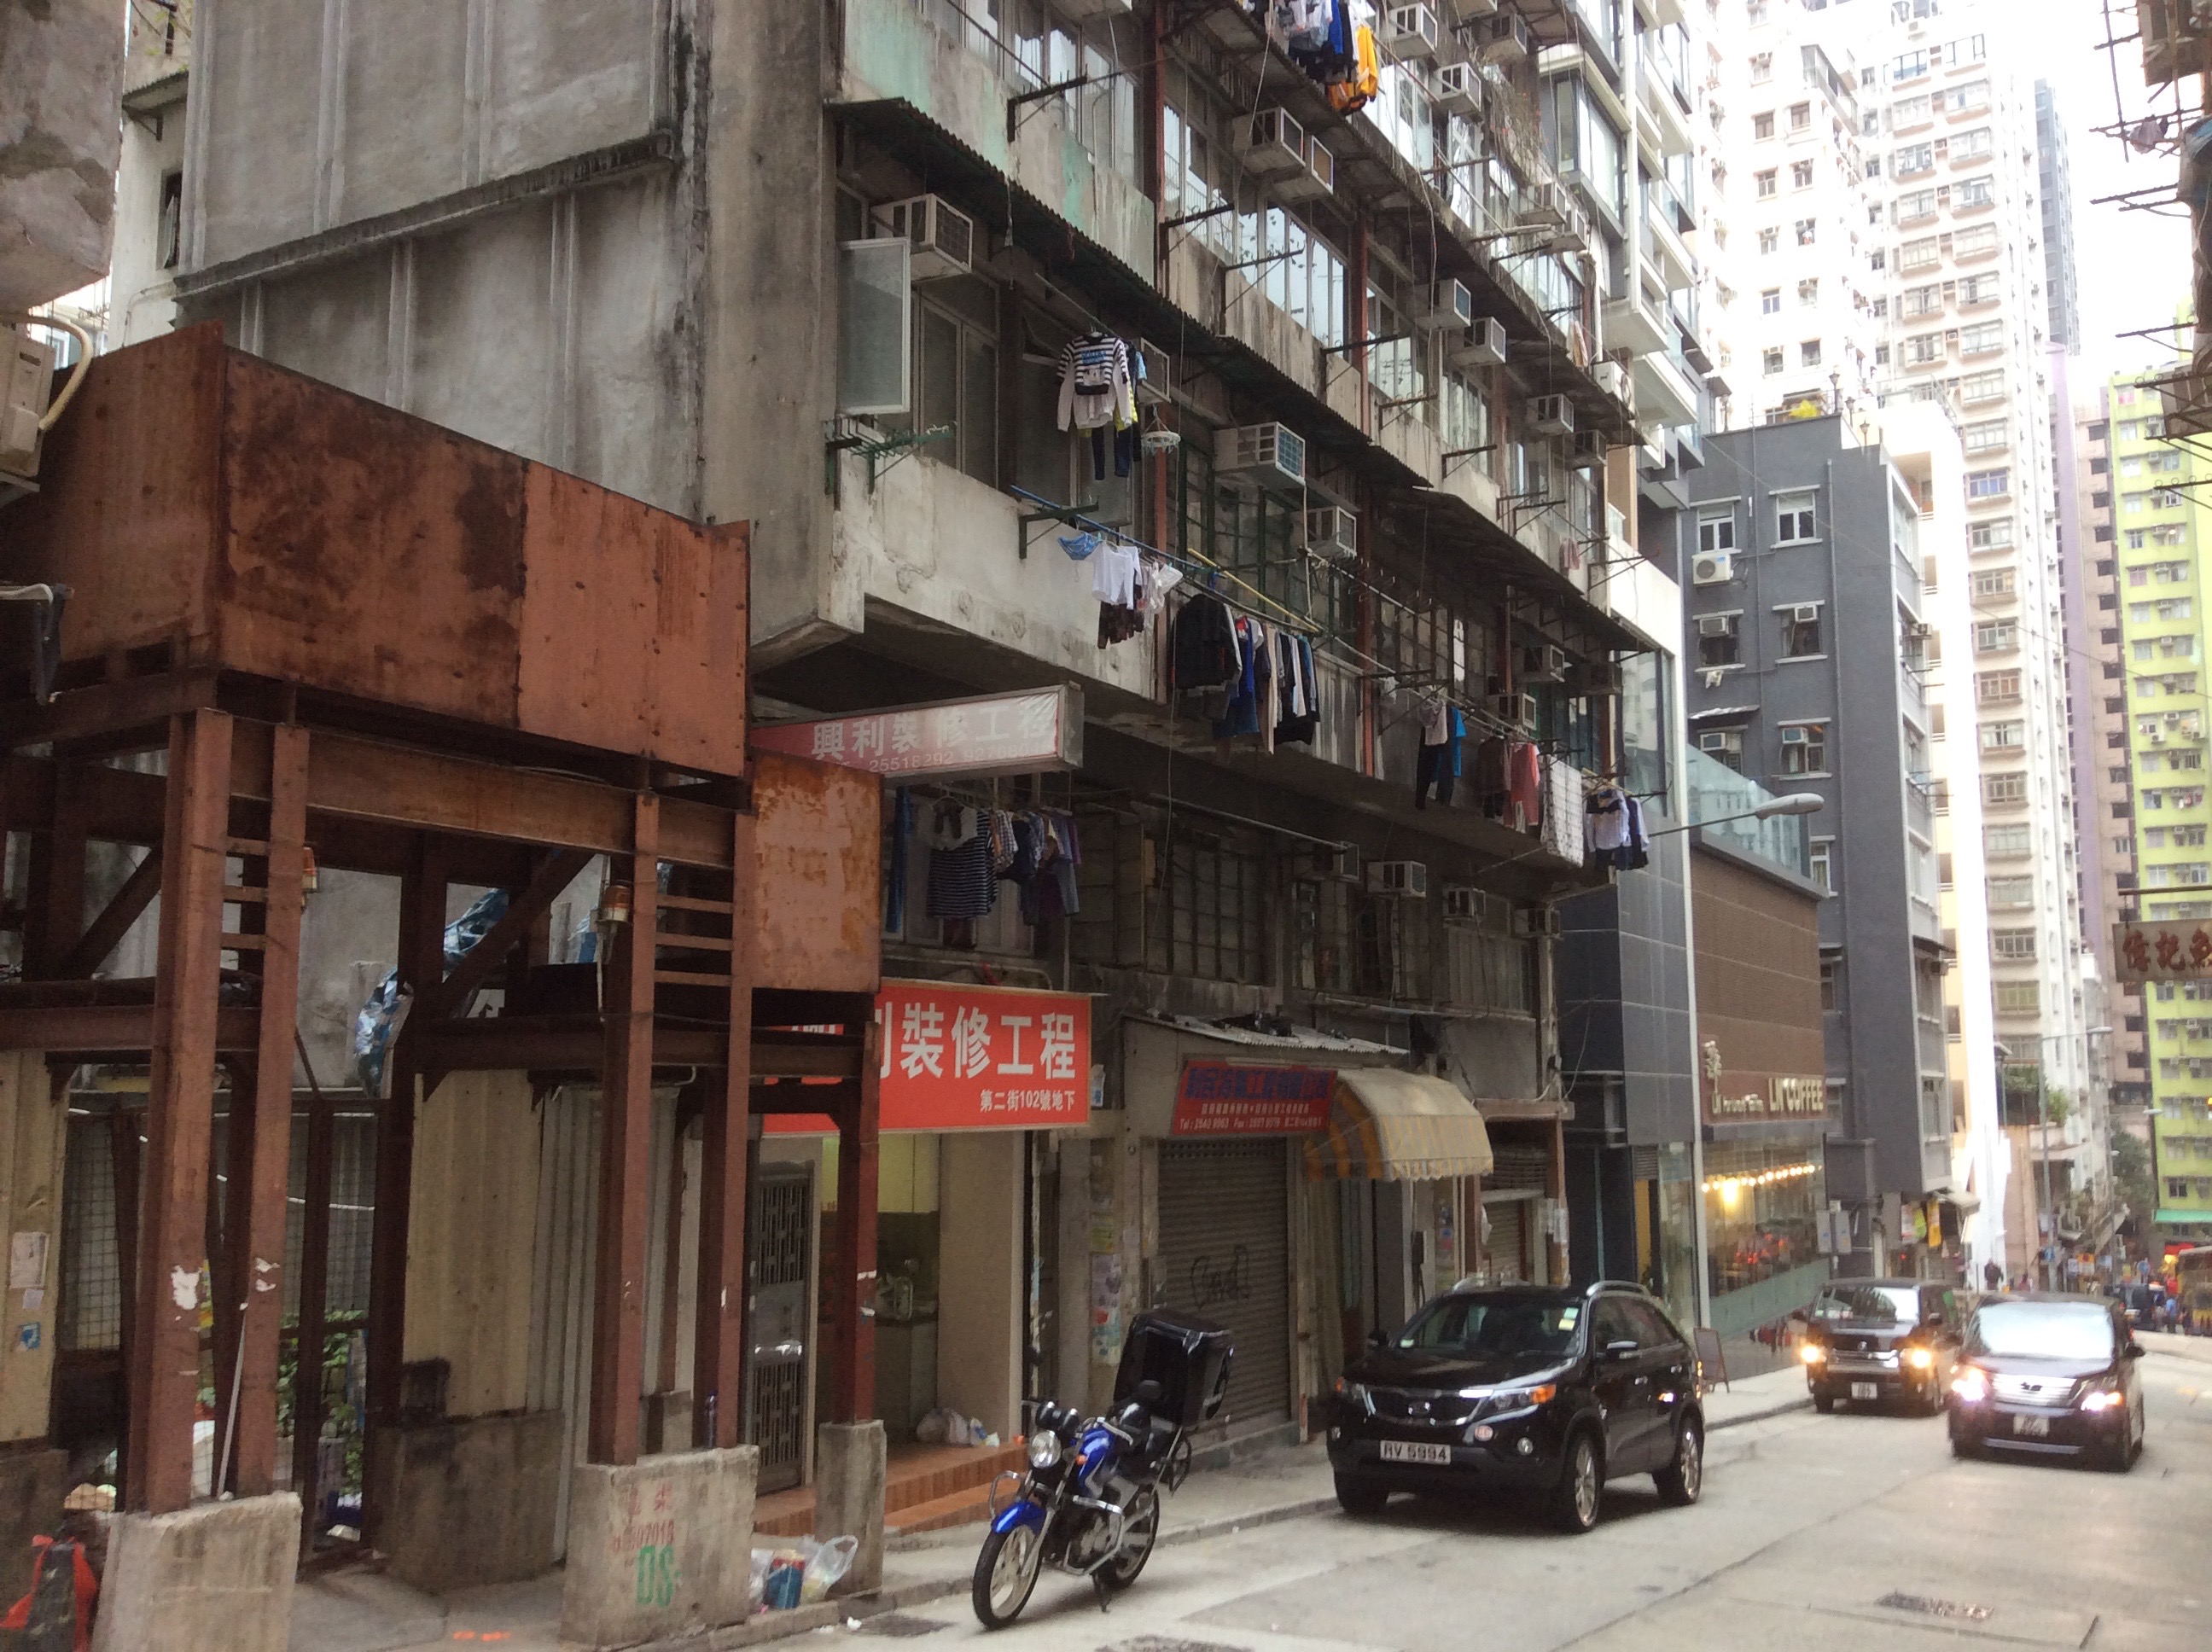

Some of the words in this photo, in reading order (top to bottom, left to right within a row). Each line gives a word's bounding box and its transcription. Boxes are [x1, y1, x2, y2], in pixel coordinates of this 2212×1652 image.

[812, 702, 1050, 760] 興利裝修工程
[980, 1088, 1075, 1112] 第二街102號地下
